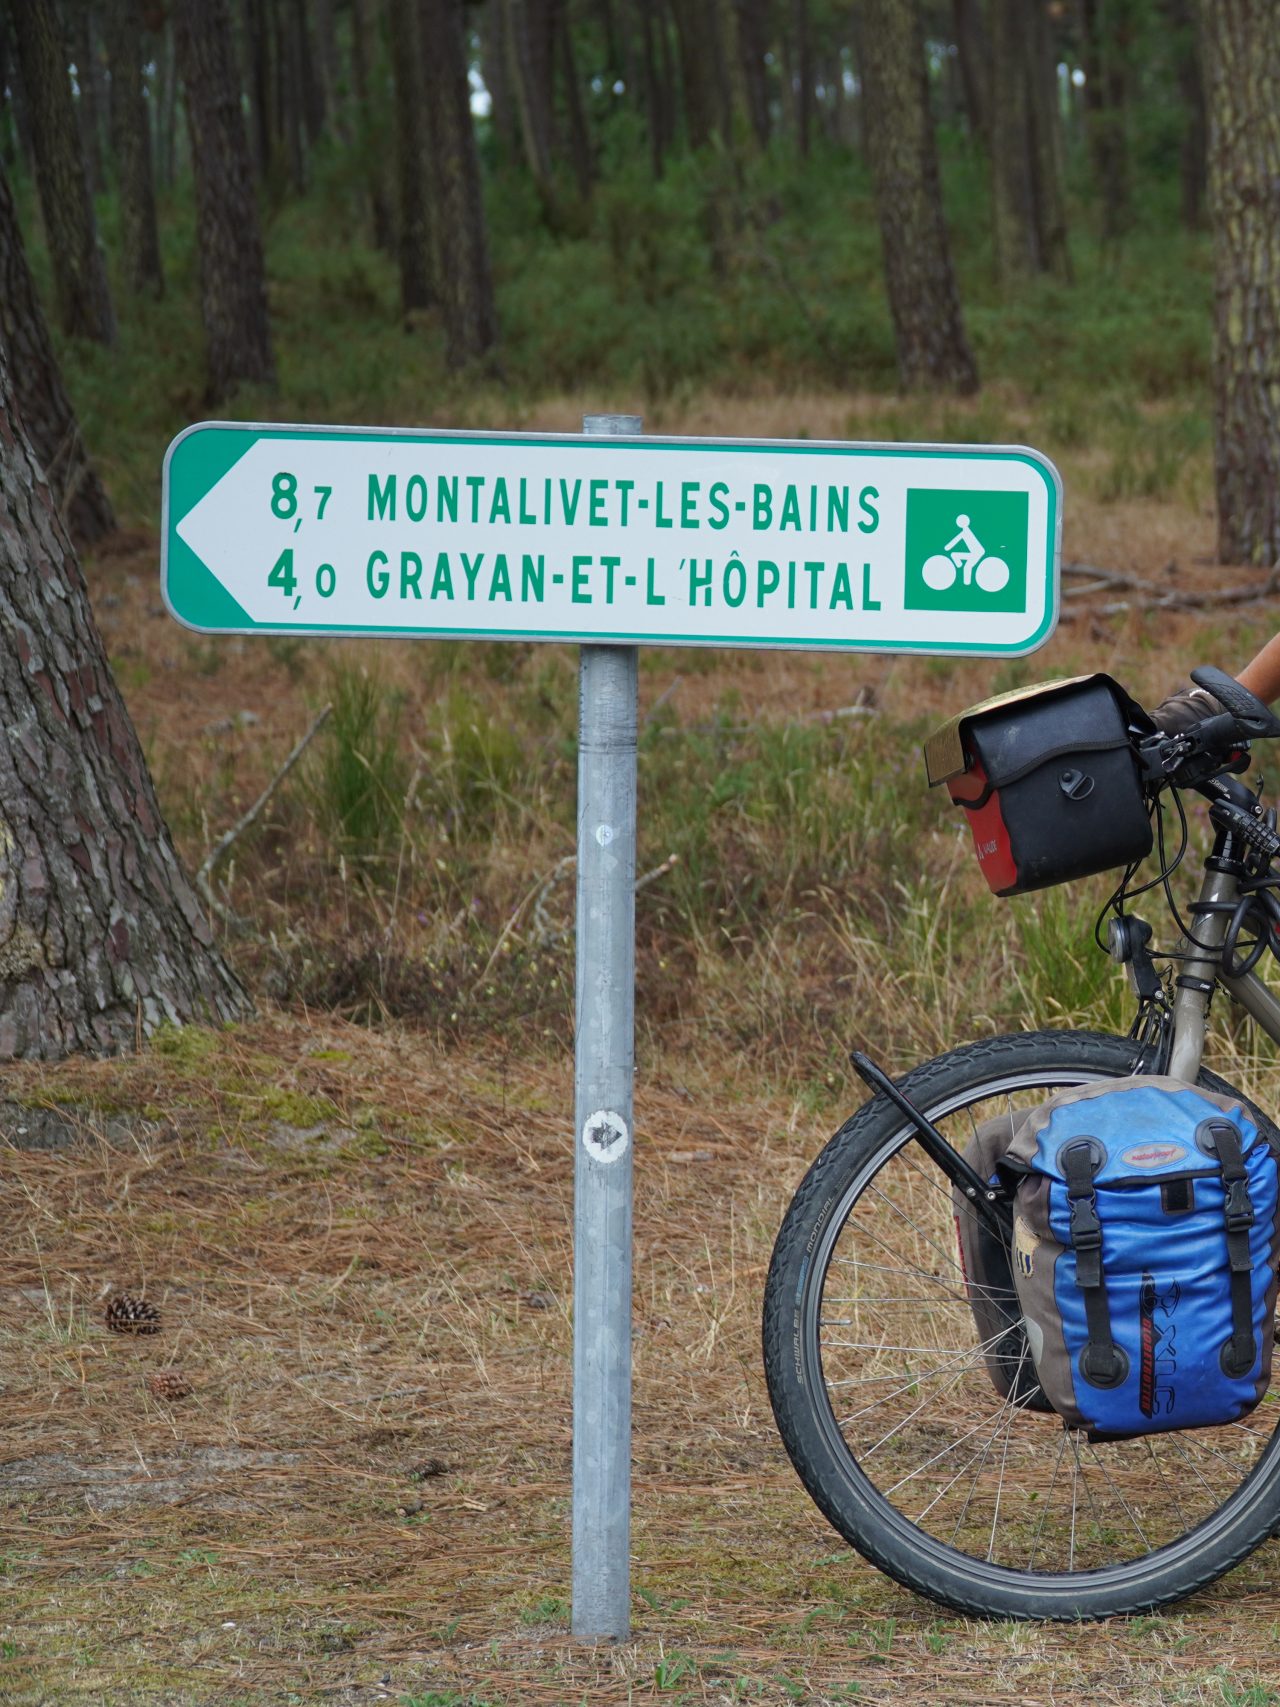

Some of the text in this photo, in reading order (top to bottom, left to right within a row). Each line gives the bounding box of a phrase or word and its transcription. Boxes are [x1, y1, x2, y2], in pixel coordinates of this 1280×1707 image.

[367, 473, 880, 534] MONTALIVET-LES-BAINS
[806, 1196, 834, 1254] MONDIAL
[1142, 1318, 1153, 1410] GLOBETROTTER
